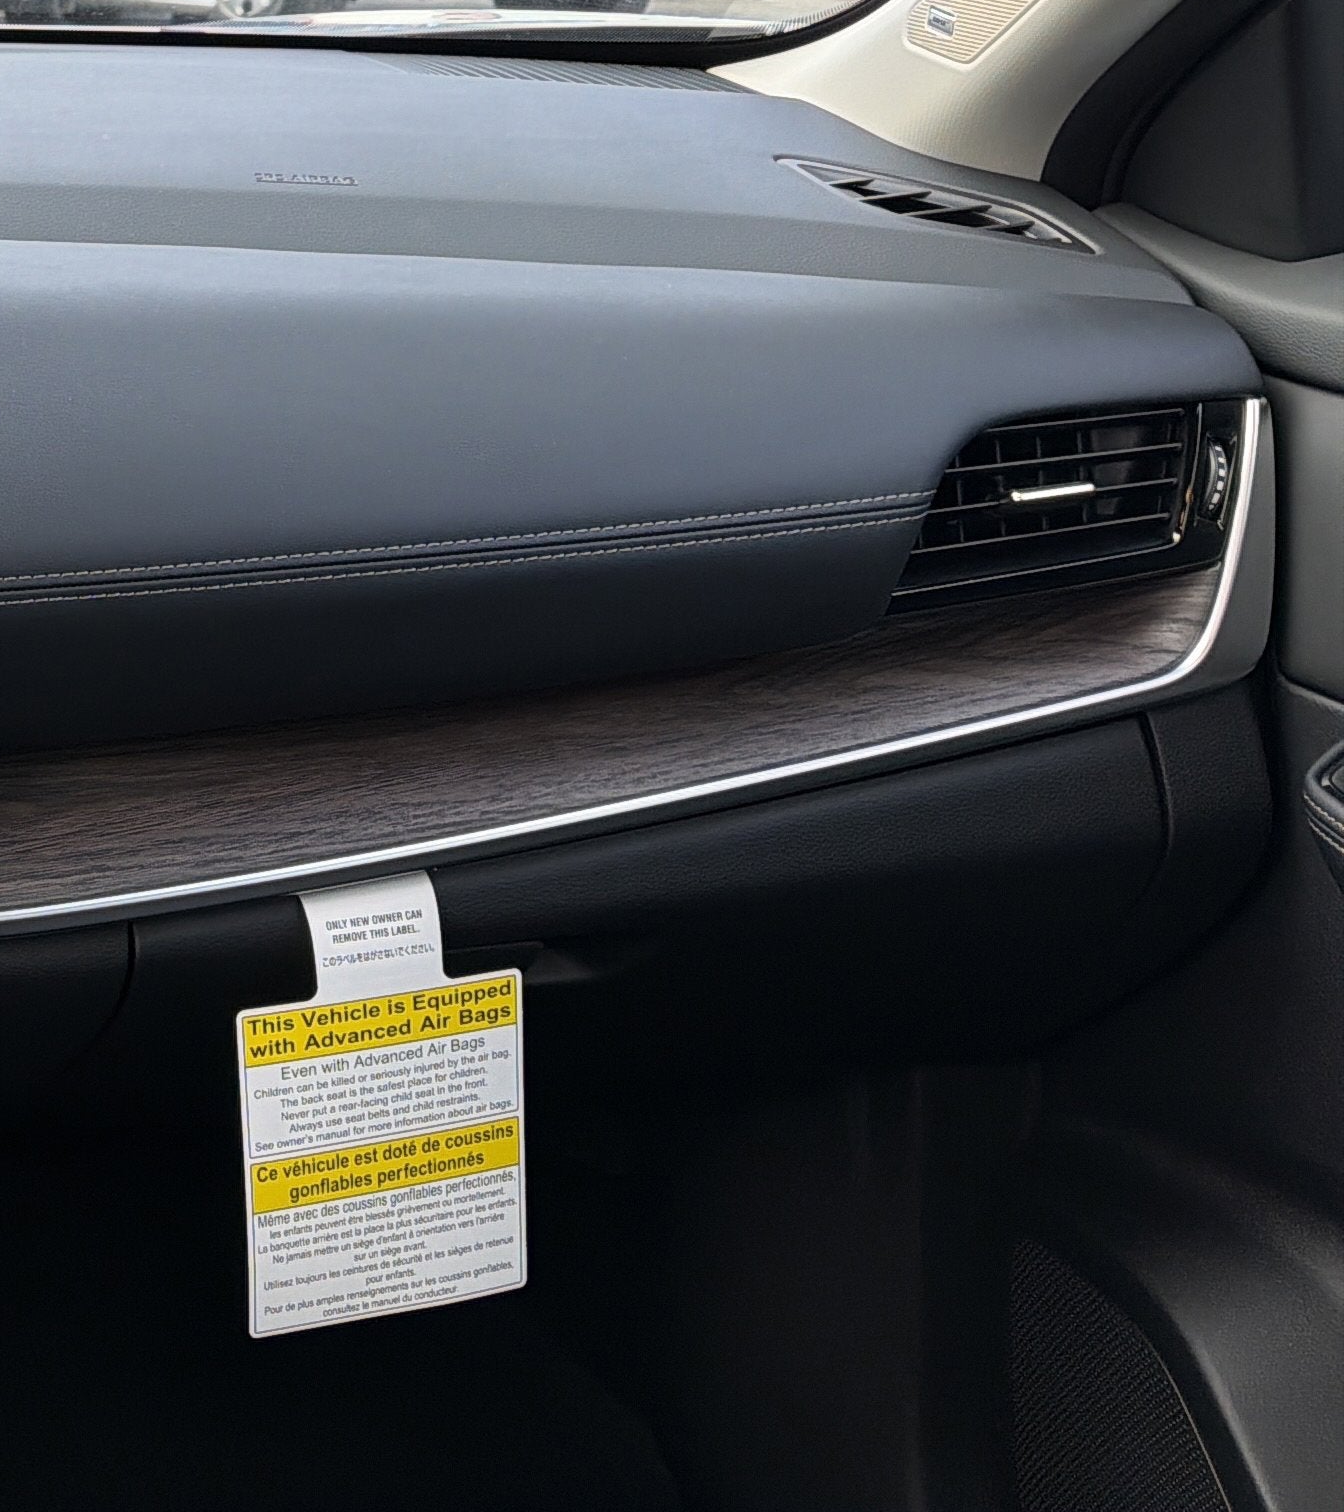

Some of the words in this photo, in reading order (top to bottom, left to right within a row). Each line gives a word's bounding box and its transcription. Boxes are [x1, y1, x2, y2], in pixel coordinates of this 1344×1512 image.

[325, 917, 348, 931] ONLY
[350, 915, 370, 929] NEW
[372, 912, 404, 926] OWNER
[405, 908, 423, 922] CAN
[332, 930, 369, 945] REMOVE
[370, 928, 390, 941] THIS
[391, 924, 421, 938] LABEL.
[247, 1017, 294, 1036] This
[301, 1003, 381, 1029] Vehicle
[387, 997, 405, 1016] is
[412, 979, 512, 1013] Equipped
[249, 1037, 296, 1060] with
[305, 1020, 412, 1051] Advanced
[420, 1013, 451, 1032] Air
[459, 1002, 512, 1029] Bags
[254, 1086, 294, 1100] Children
[296, 1084, 314, 1094] can
[316, 1080, 329, 1090] be
[331, 1075, 355, 1088] killed
[357, 1074, 367, 1083] or
[370, 1067, 411, 1083] seriously
[413, 1059, 445, 1074] injured
[447, 1058, 458, 1070] by
[460, 1055, 476, 1066] the
[477, 1052, 490, 1063] air
[492, 1049, 512, 1062] bag.
[281, 1063, 317, 1080] Even
[321, 1059, 350, 1074] with
[353, 1044, 422, 1070] Advanced
[427, 1041, 446, 1058] Air
[450, 1036, 486, 1058] Bags
[256, 1167, 278, 1184] Ce
[283, 1155, 350, 1179] véhicule
[354, 1150, 379, 1166] est
[382, 1140, 417, 1161] doté
[422, 1136, 441, 1153] de
[444, 1123, 515, 1150] coussins
[289, 1171, 373, 1204] gonflables
[377, 1151, 486, 1188] perfectionnés
